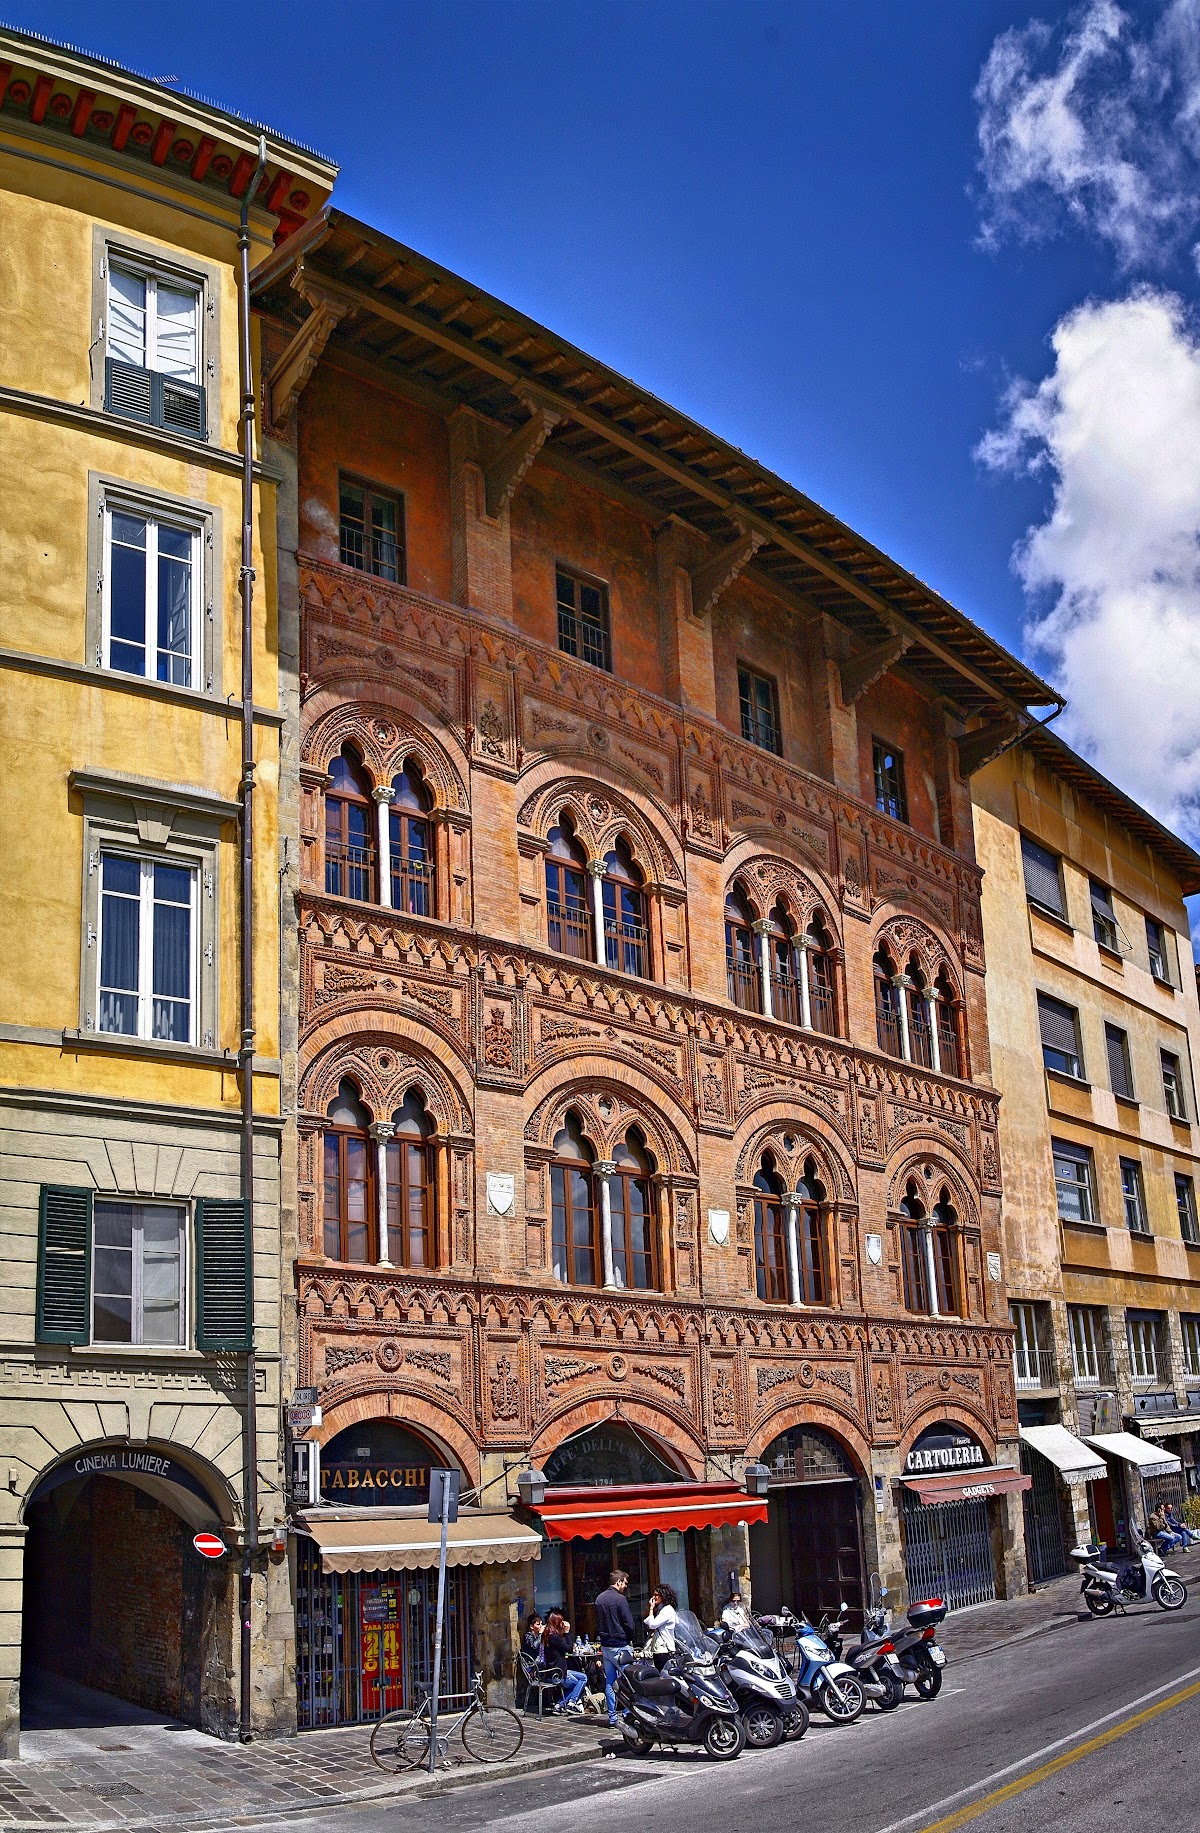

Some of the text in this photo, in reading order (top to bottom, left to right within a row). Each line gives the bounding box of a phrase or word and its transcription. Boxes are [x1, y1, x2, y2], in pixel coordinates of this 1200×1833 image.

[75, 1453, 170, 1476] CINEMA LUMIERE
[548, 1446, 578, 1479] AFFE'
[907, 1446, 984, 1469] CARTOLERIA
[320, 1468, 426, 1489] TABACCHI
[595, 1479, 613, 1487] 1794
[962, 1484, 995, 1496] GADGETS
[364, 1630, 400, 1658] 24
[364, 1656, 399, 1671] ORE
